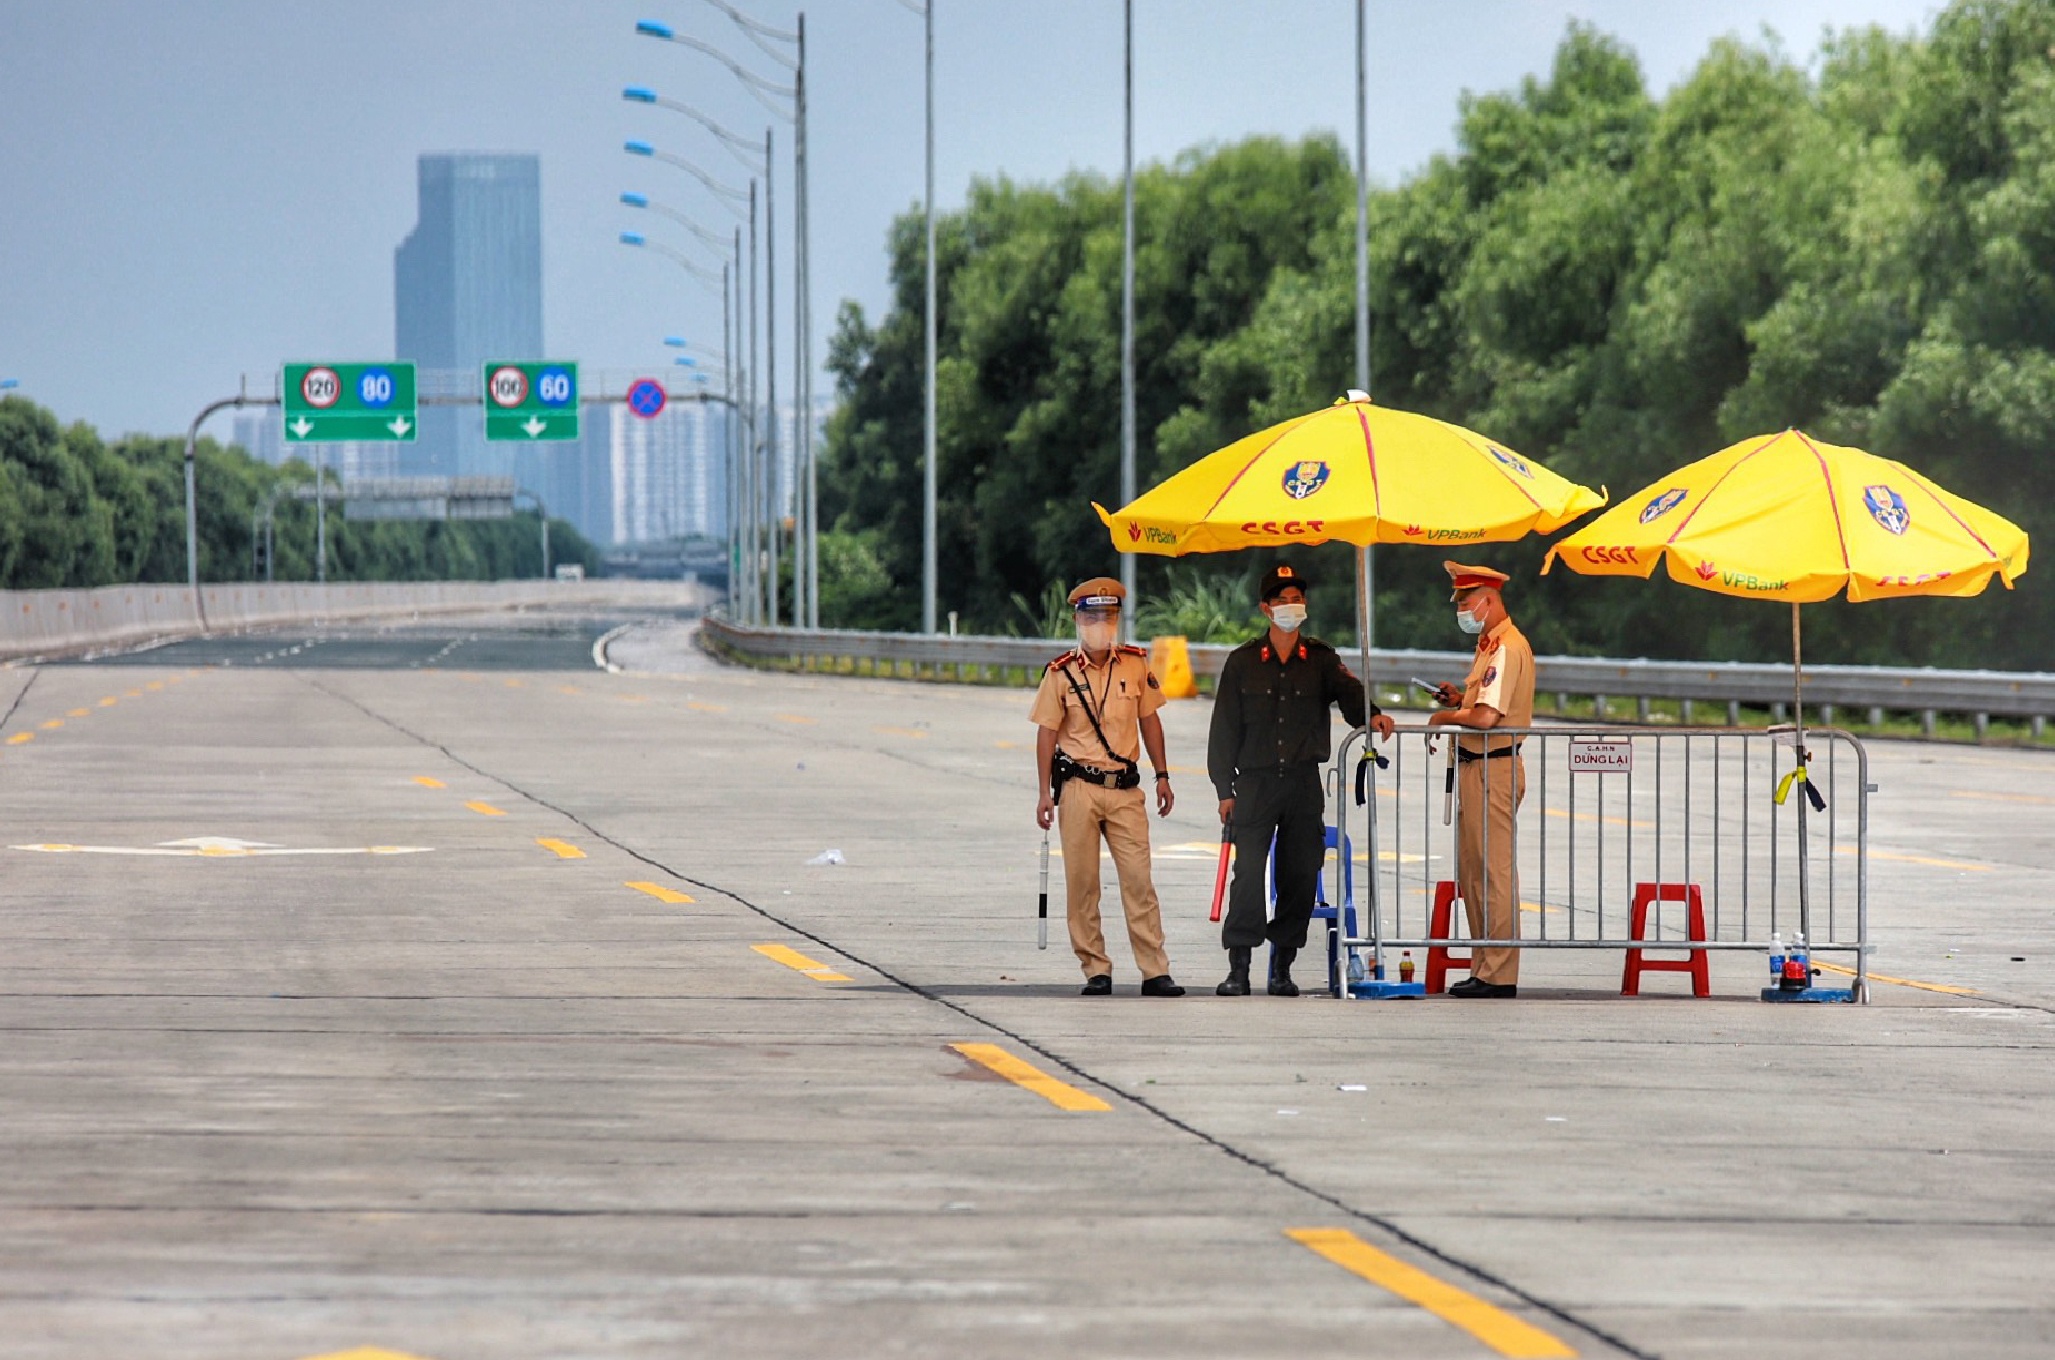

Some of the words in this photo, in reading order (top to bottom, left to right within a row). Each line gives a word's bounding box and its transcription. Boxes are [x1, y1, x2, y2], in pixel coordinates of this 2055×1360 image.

[308, 378, 335, 397] 120
[362, 374, 391, 402] 80
[495, 377, 523, 397] 100
[540, 374, 569, 402] 60
[1143, 526, 1178, 545] VPBank
[1240, 520, 1324, 536] CSGT
[1427, 528, 1487, 540] VPBank
[1582, 545, 1638, 565] CSGT
[1723, 570, 1790, 591] VPBank
[1608, 755, 1628, 767] LẠI
